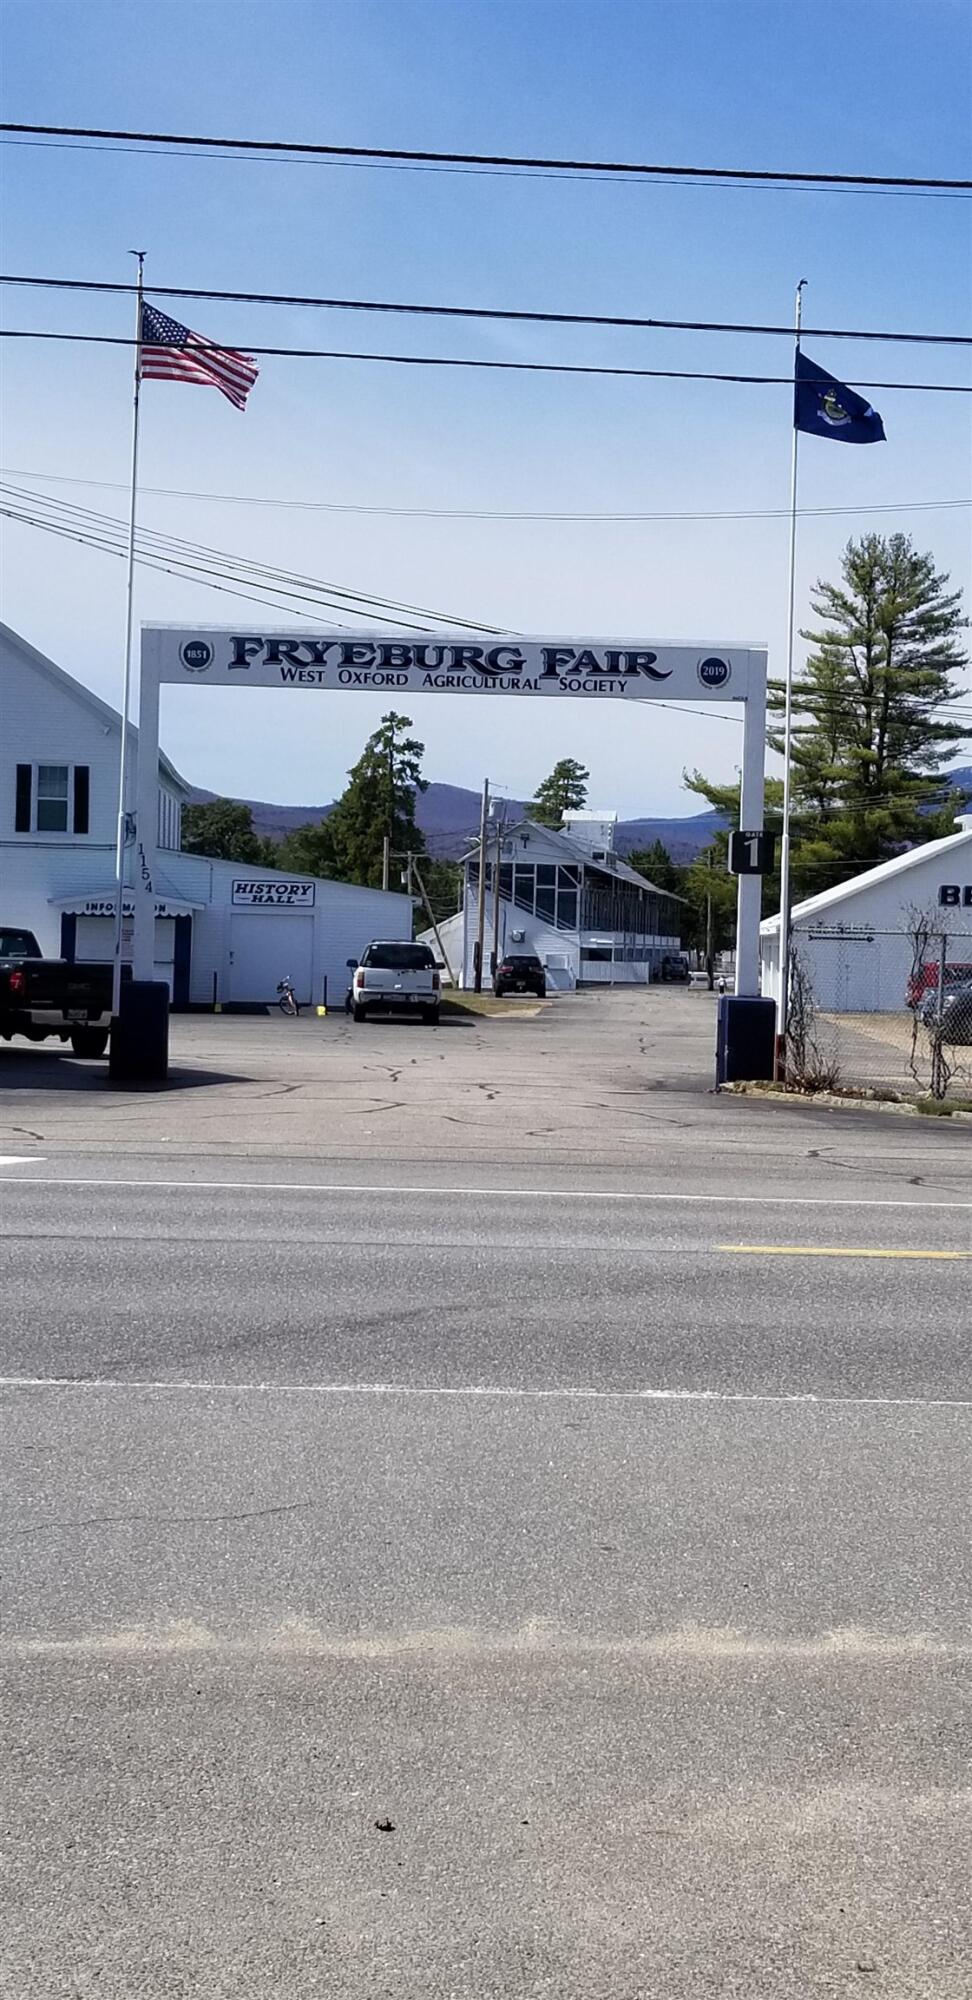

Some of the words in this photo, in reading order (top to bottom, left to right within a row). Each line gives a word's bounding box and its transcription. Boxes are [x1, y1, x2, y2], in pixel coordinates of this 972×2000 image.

[187, 649, 206, 659] 1851
[228, 637, 527, 676] FRYEBURG
[539, 647, 673, 681] FAIR
[280, 667, 325, 682] WEST
[338, 669, 409, 685] OXFORD
[422, 673, 541, 691] AGRICULTURAL
[559, 677, 628, 692] SOCIETY
[702, 666, 725, 676] 2019
[743, 838, 758, 867] 1
[138, 843, 153, 893] 1154
[235, 883, 312, 896] HISTORY
[250, 894, 295, 904] HALL
